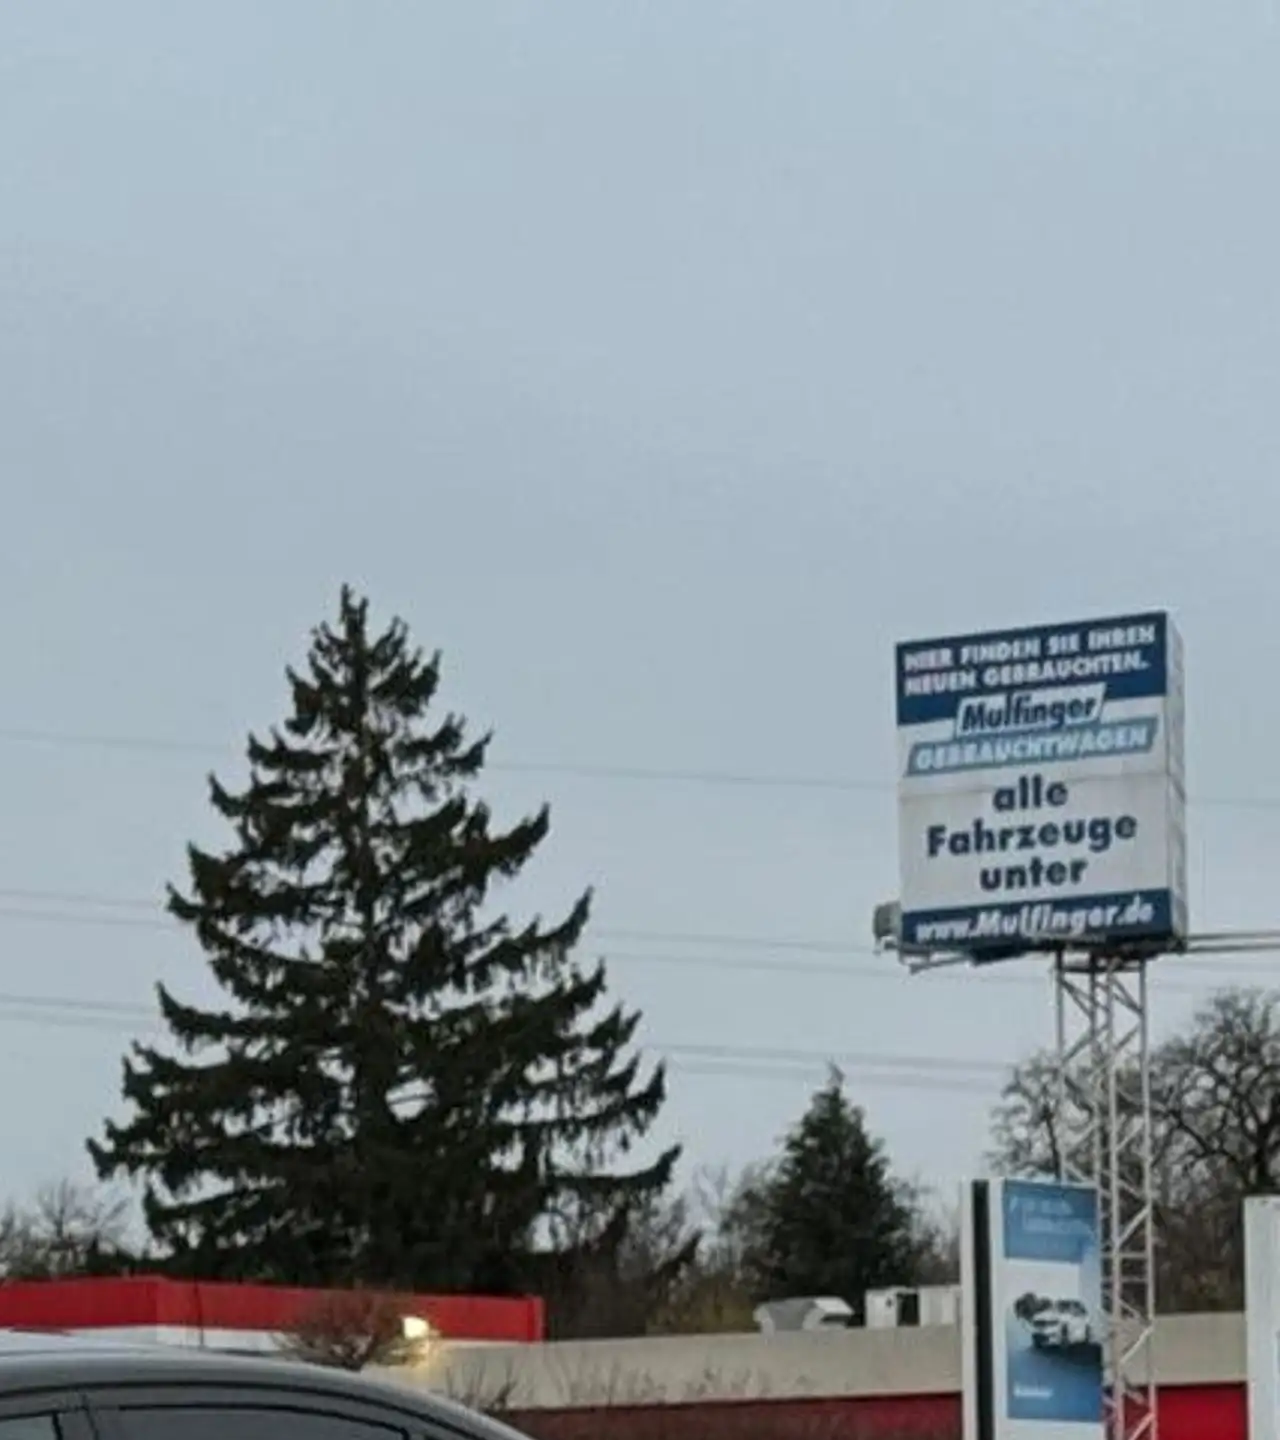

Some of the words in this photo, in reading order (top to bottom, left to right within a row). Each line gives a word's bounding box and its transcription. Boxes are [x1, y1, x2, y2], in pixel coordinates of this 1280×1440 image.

[960, 637, 1041, 664] FINDEN
[1047, 632, 1080, 654] SIE
[1088, 624, 1155, 650] IHREN
[904, 671, 978, 696] NEUEN
[962, 691, 1097, 731] Mulfinger
[917, 728, 1148, 769] GEBRAUCHTWAGEN
[992, 774, 1068, 812] alle
[928, 815, 1137, 858] Fahrzeuge
[980, 857, 1089, 892] unter
[915, 897, 1154, 940] www.Mulfinger.de
